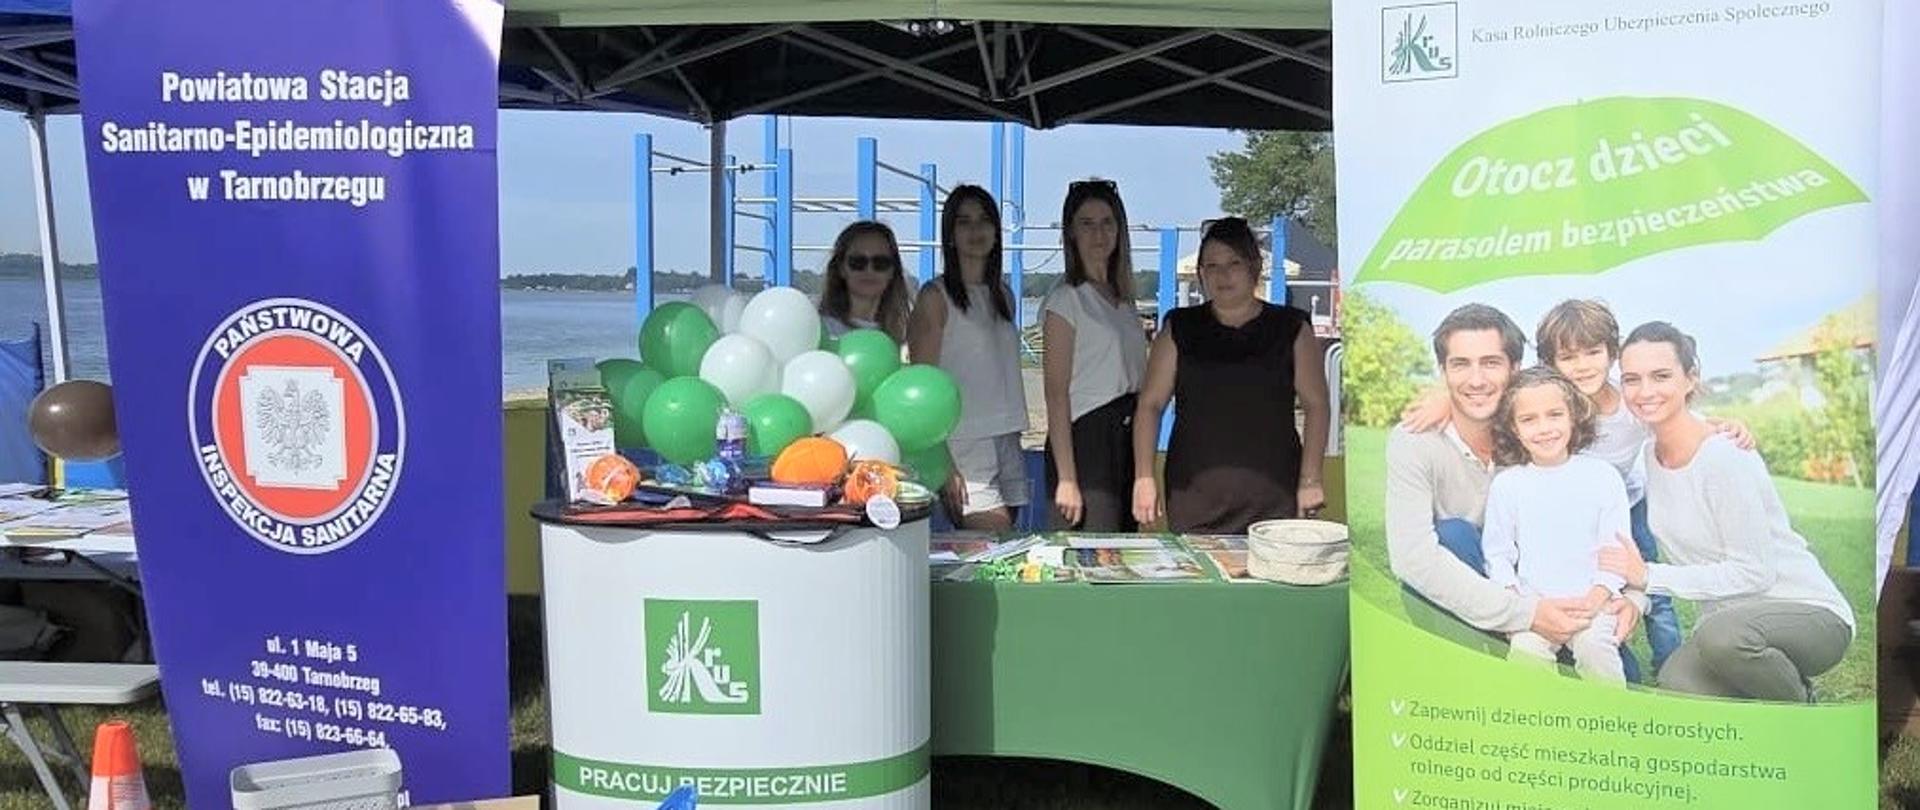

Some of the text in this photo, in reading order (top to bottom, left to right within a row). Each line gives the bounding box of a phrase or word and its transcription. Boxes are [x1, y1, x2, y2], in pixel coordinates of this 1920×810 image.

[1472, 28, 1508, 43] Kasa
[1513, 20, 1599, 40] Rolniczego
[1604, 11, 1719, 32] Ubezpieczenia
[162, 69, 409, 107] Powiatowa Stacja
[102, 119, 474, 157] Sanitarno-Epidemiologiczna
[1451, 112, 1734, 199] Otocz dzieci
[187, 170, 384, 207] w Tarnobrzegu
[1379, 167, 1830, 271] parasolem bezpieczeństwa
[213, 306, 365, 363] PAŃSTWOWA
[201, 444, 396, 547] INSPEKCJA SANITARNA
[266, 636, 357, 663] ul. 1 Maja 5
[251, 660, 380, 696] 39-400 Tarnobrzeg
[202, 679, 225, 697] tel.
[229, 681, 254, 705] (15)
[335, 696, 363, 720] (15)
[285, 717, 311, 741] (15)
[1409, 700, 1744, 744] Zapewnij dzieciom opiekę dorosłych.
[1410, 733, 1788, 781] Oddziel część mieszkalną gospodarstwa
[579, 766, 672, 795] PRACUJ
[1410, 760, 1698, 804] rolnego od części produkcyjnej.
